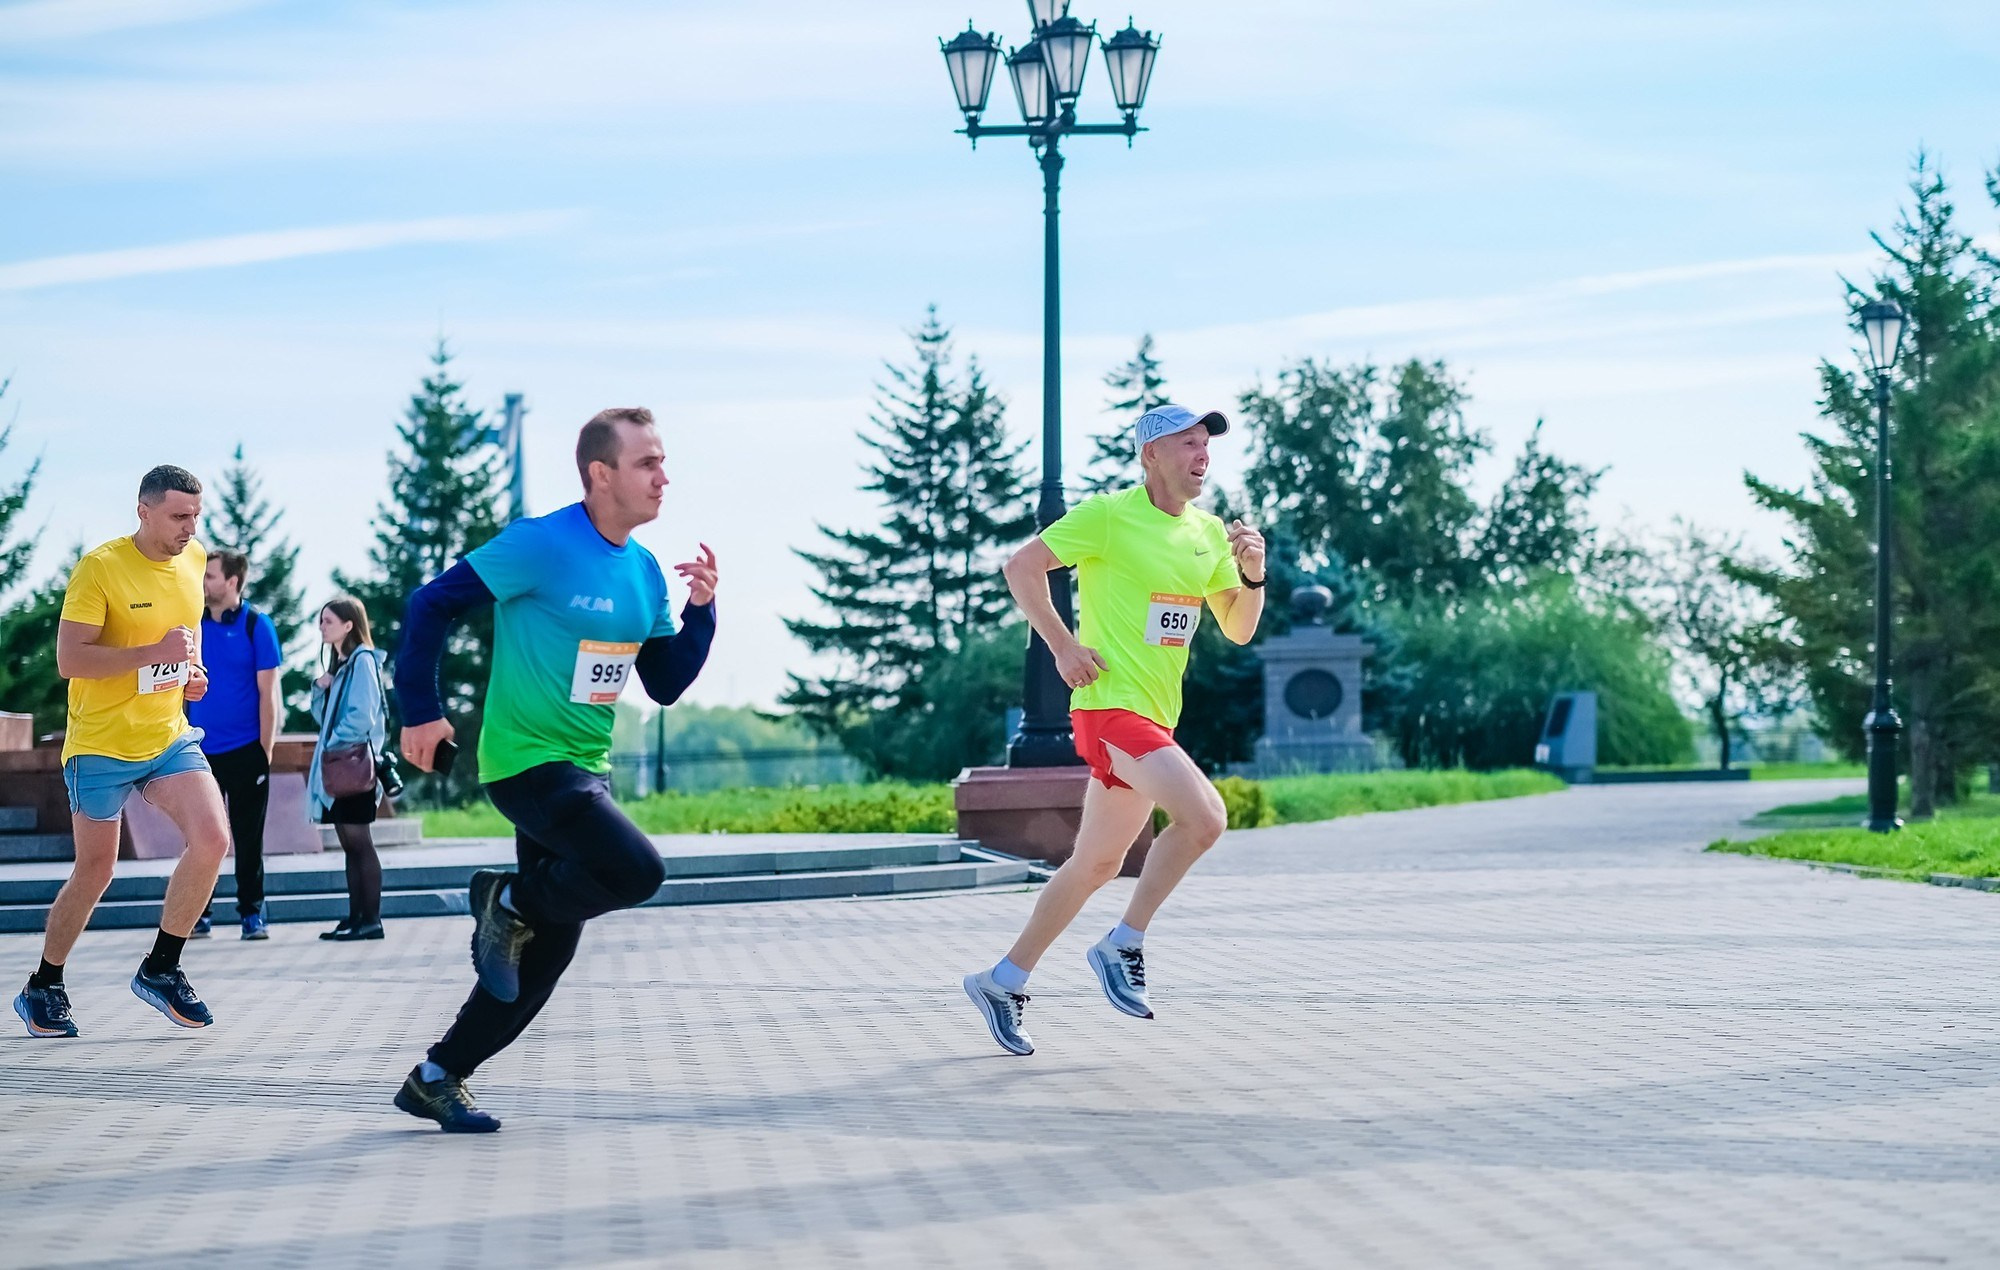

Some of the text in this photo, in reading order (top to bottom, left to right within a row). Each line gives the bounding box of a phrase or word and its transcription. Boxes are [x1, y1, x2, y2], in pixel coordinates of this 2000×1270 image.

[1160, 611, 1188, 630] 650
[151, 663, 179, 677] 720
[591, 663, 624, 683] 995
